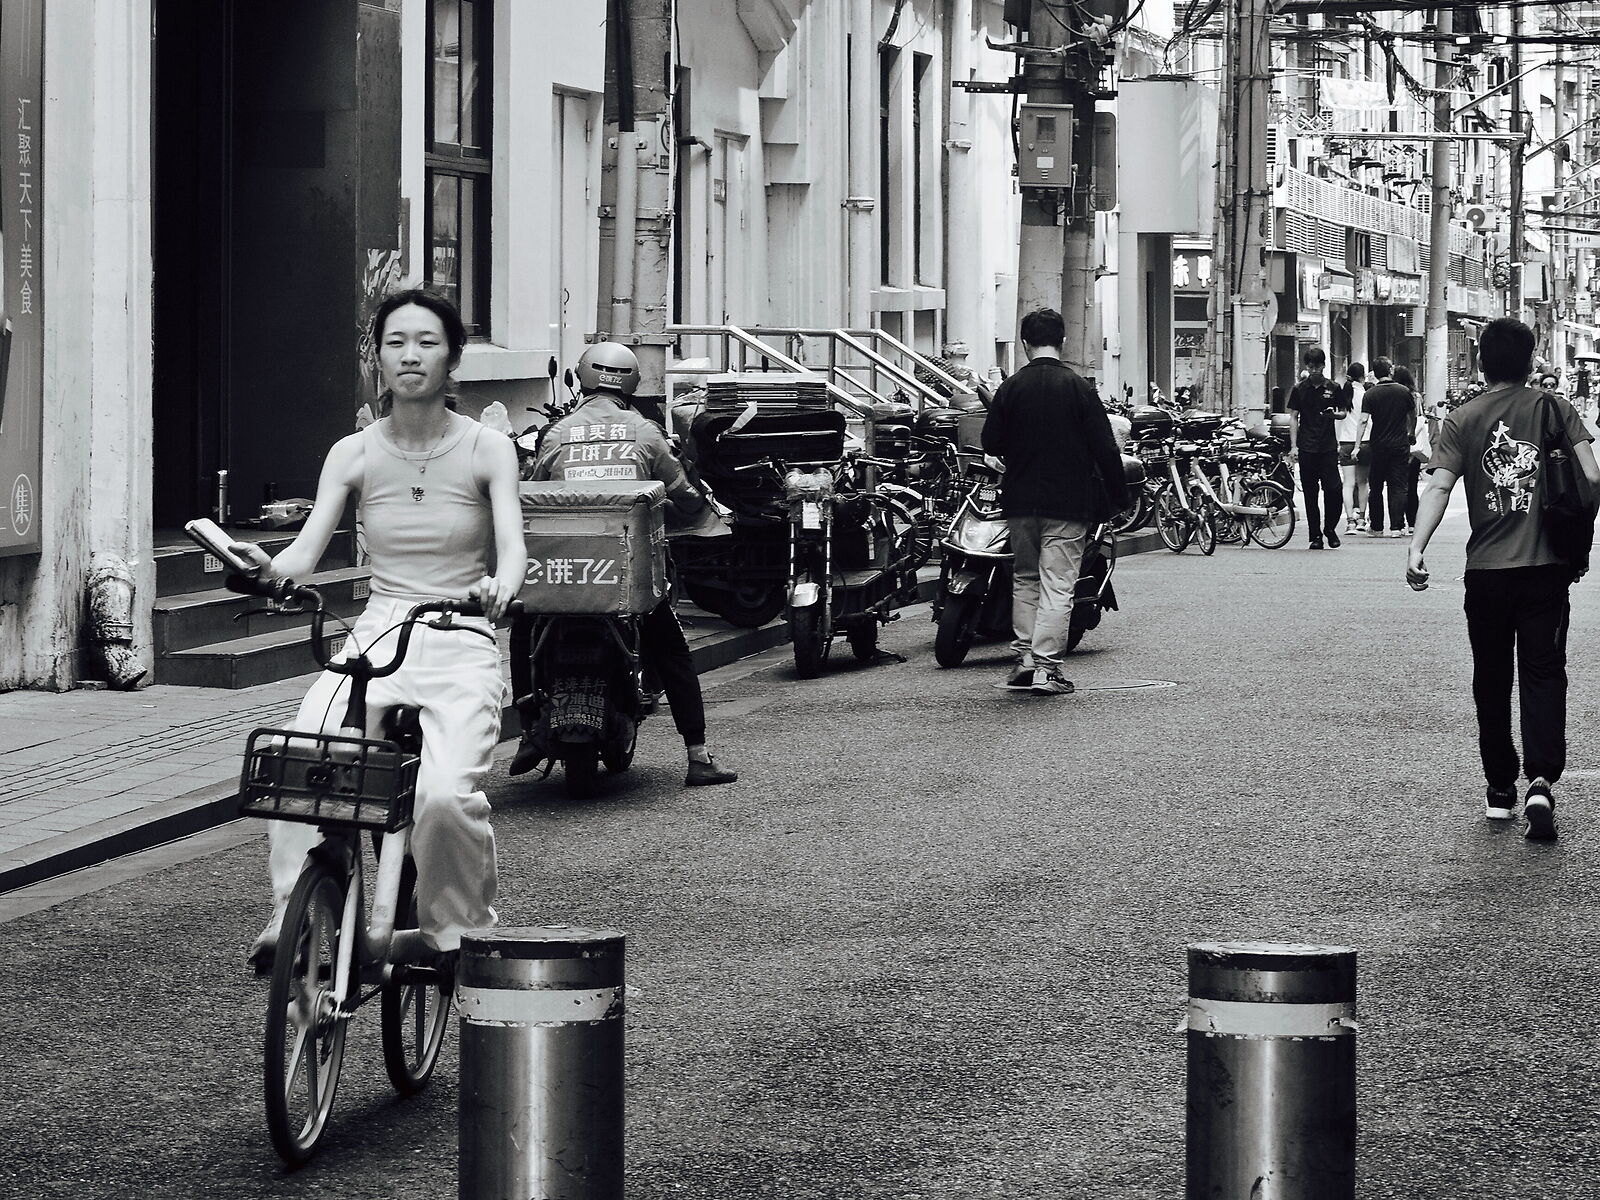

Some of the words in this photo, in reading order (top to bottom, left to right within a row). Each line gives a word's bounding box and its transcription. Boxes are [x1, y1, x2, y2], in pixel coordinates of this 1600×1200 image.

[17, 97, 33, 315] 汇聚天下美食
[569, 424, 627, 442] 急买药
[564, 443, 637, 463] 上饿了么
[15, 484, 29, 524] 集
[546, 558, 619, 585] 饿了么
